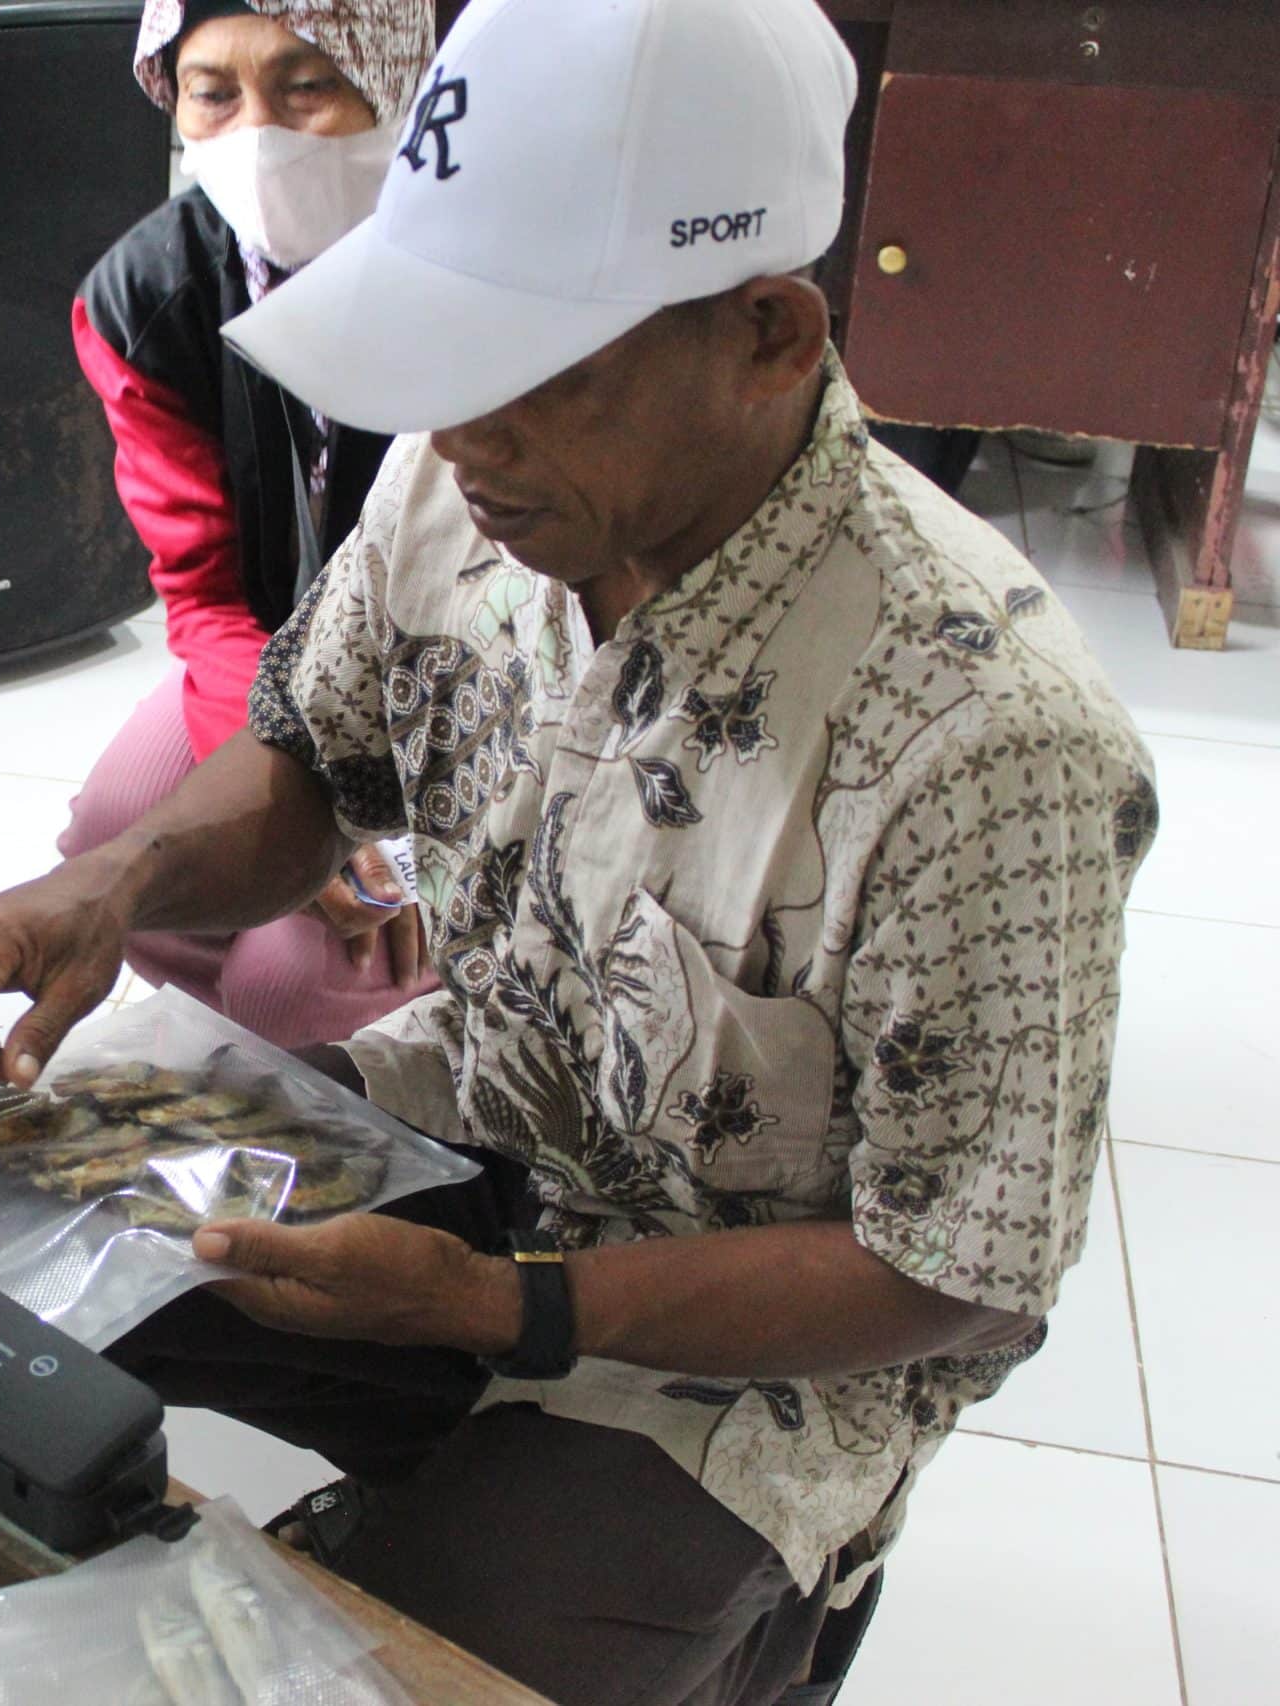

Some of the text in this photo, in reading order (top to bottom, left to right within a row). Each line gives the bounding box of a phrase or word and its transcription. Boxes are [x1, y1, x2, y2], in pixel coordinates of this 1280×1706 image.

[397, 64, 467, 180] R
[670, 207, 766, 248] SPORT
[393, 851, 417, 891] LAU
